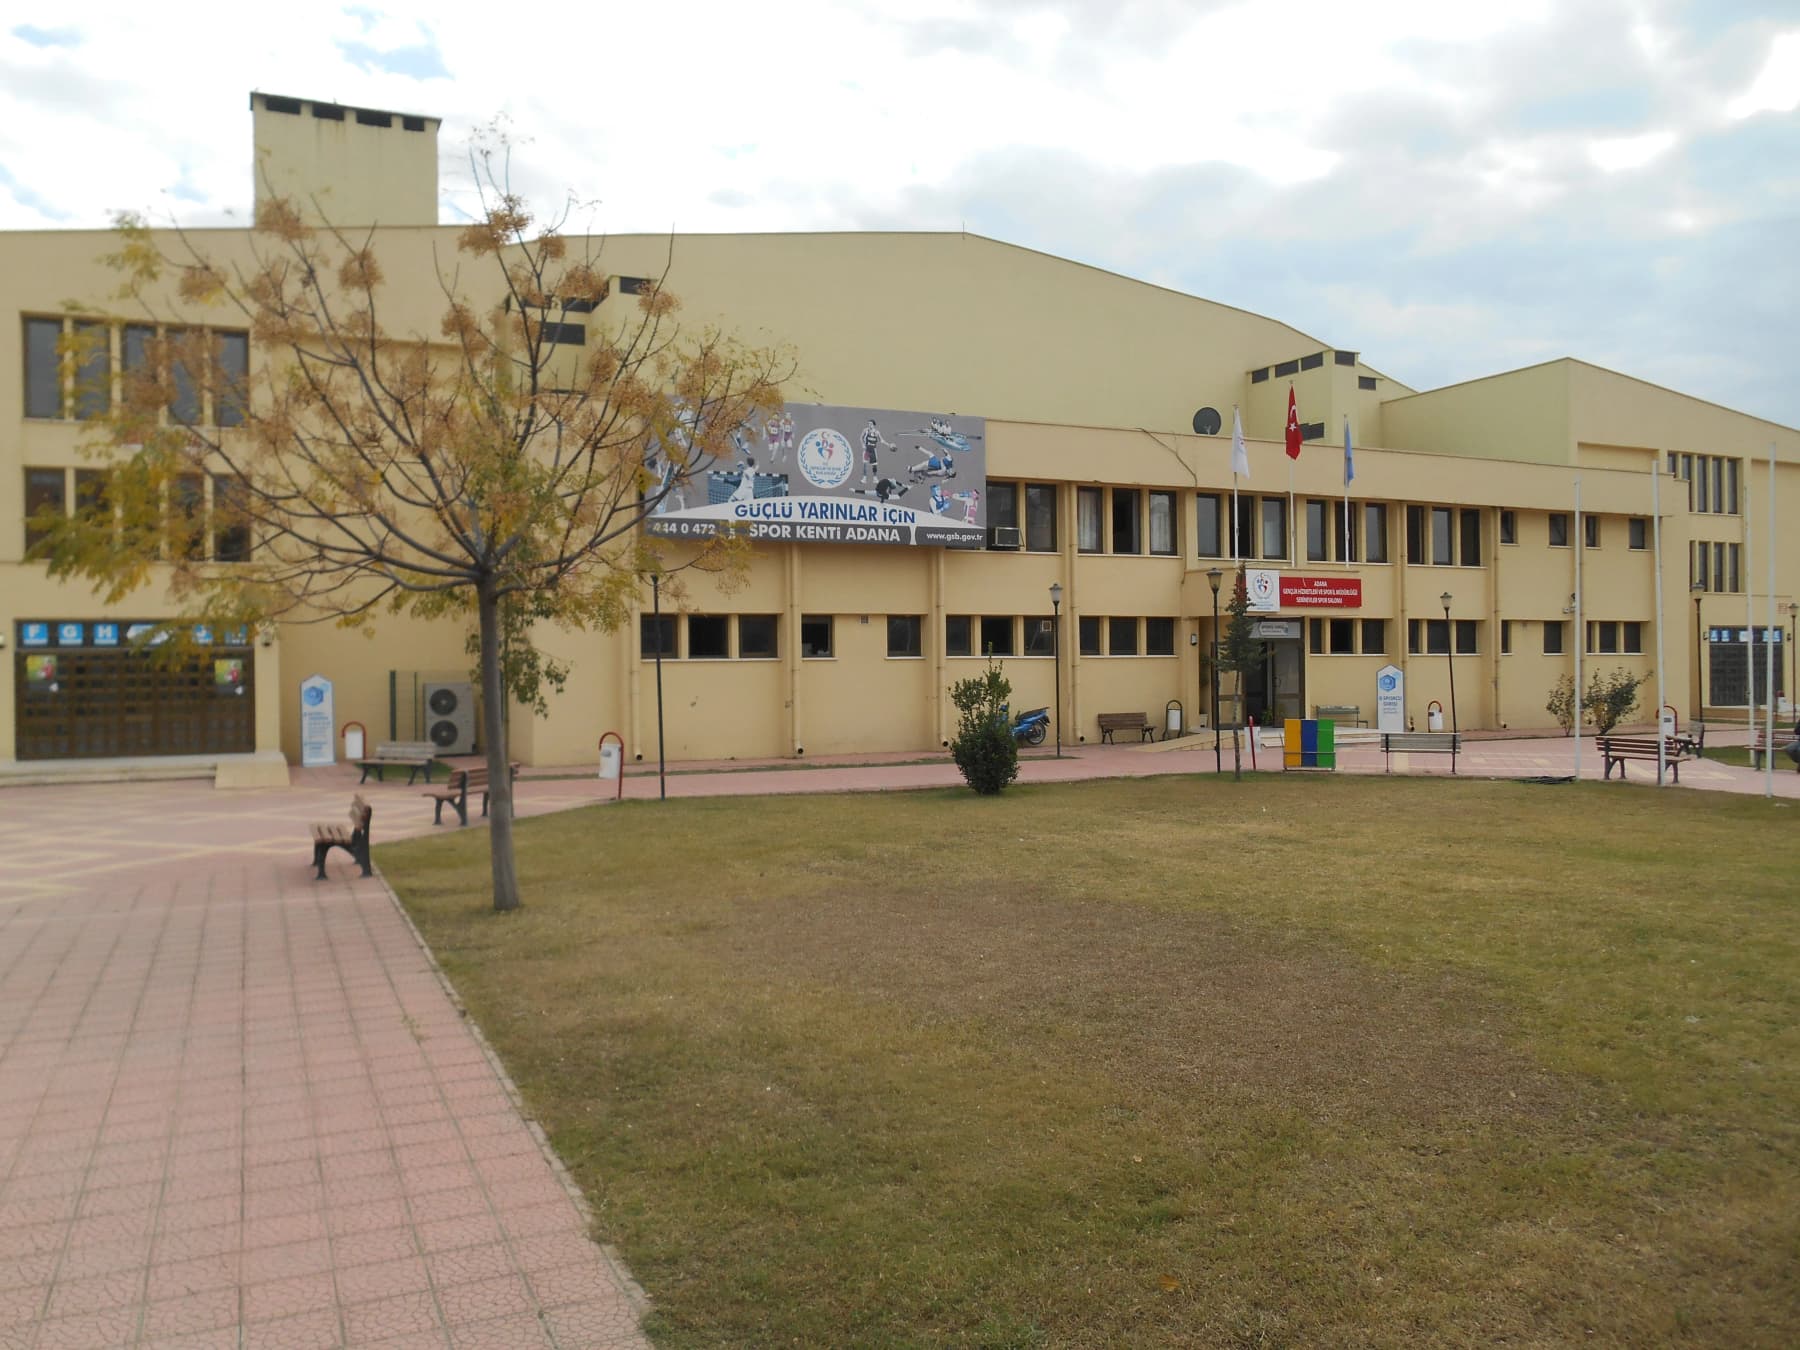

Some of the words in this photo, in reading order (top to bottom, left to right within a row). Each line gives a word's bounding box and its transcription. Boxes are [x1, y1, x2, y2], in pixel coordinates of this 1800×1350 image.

[735, 502, 793, 520] GÜÇLÜ
[798, 502, 878, 522] YARINLAR
[681, 523, 689, 534] 0
[692, 524, 716, 535] 472
[749, 523, 791, 538] SPOR
[846, 528, 900, 542] ADANA
[926, 532, 983, 542] www.gsb.gov.tr
[28, 623, 40, 638] F
[62, 623, 77, 638] G
[98, 623, 112, 638] H
